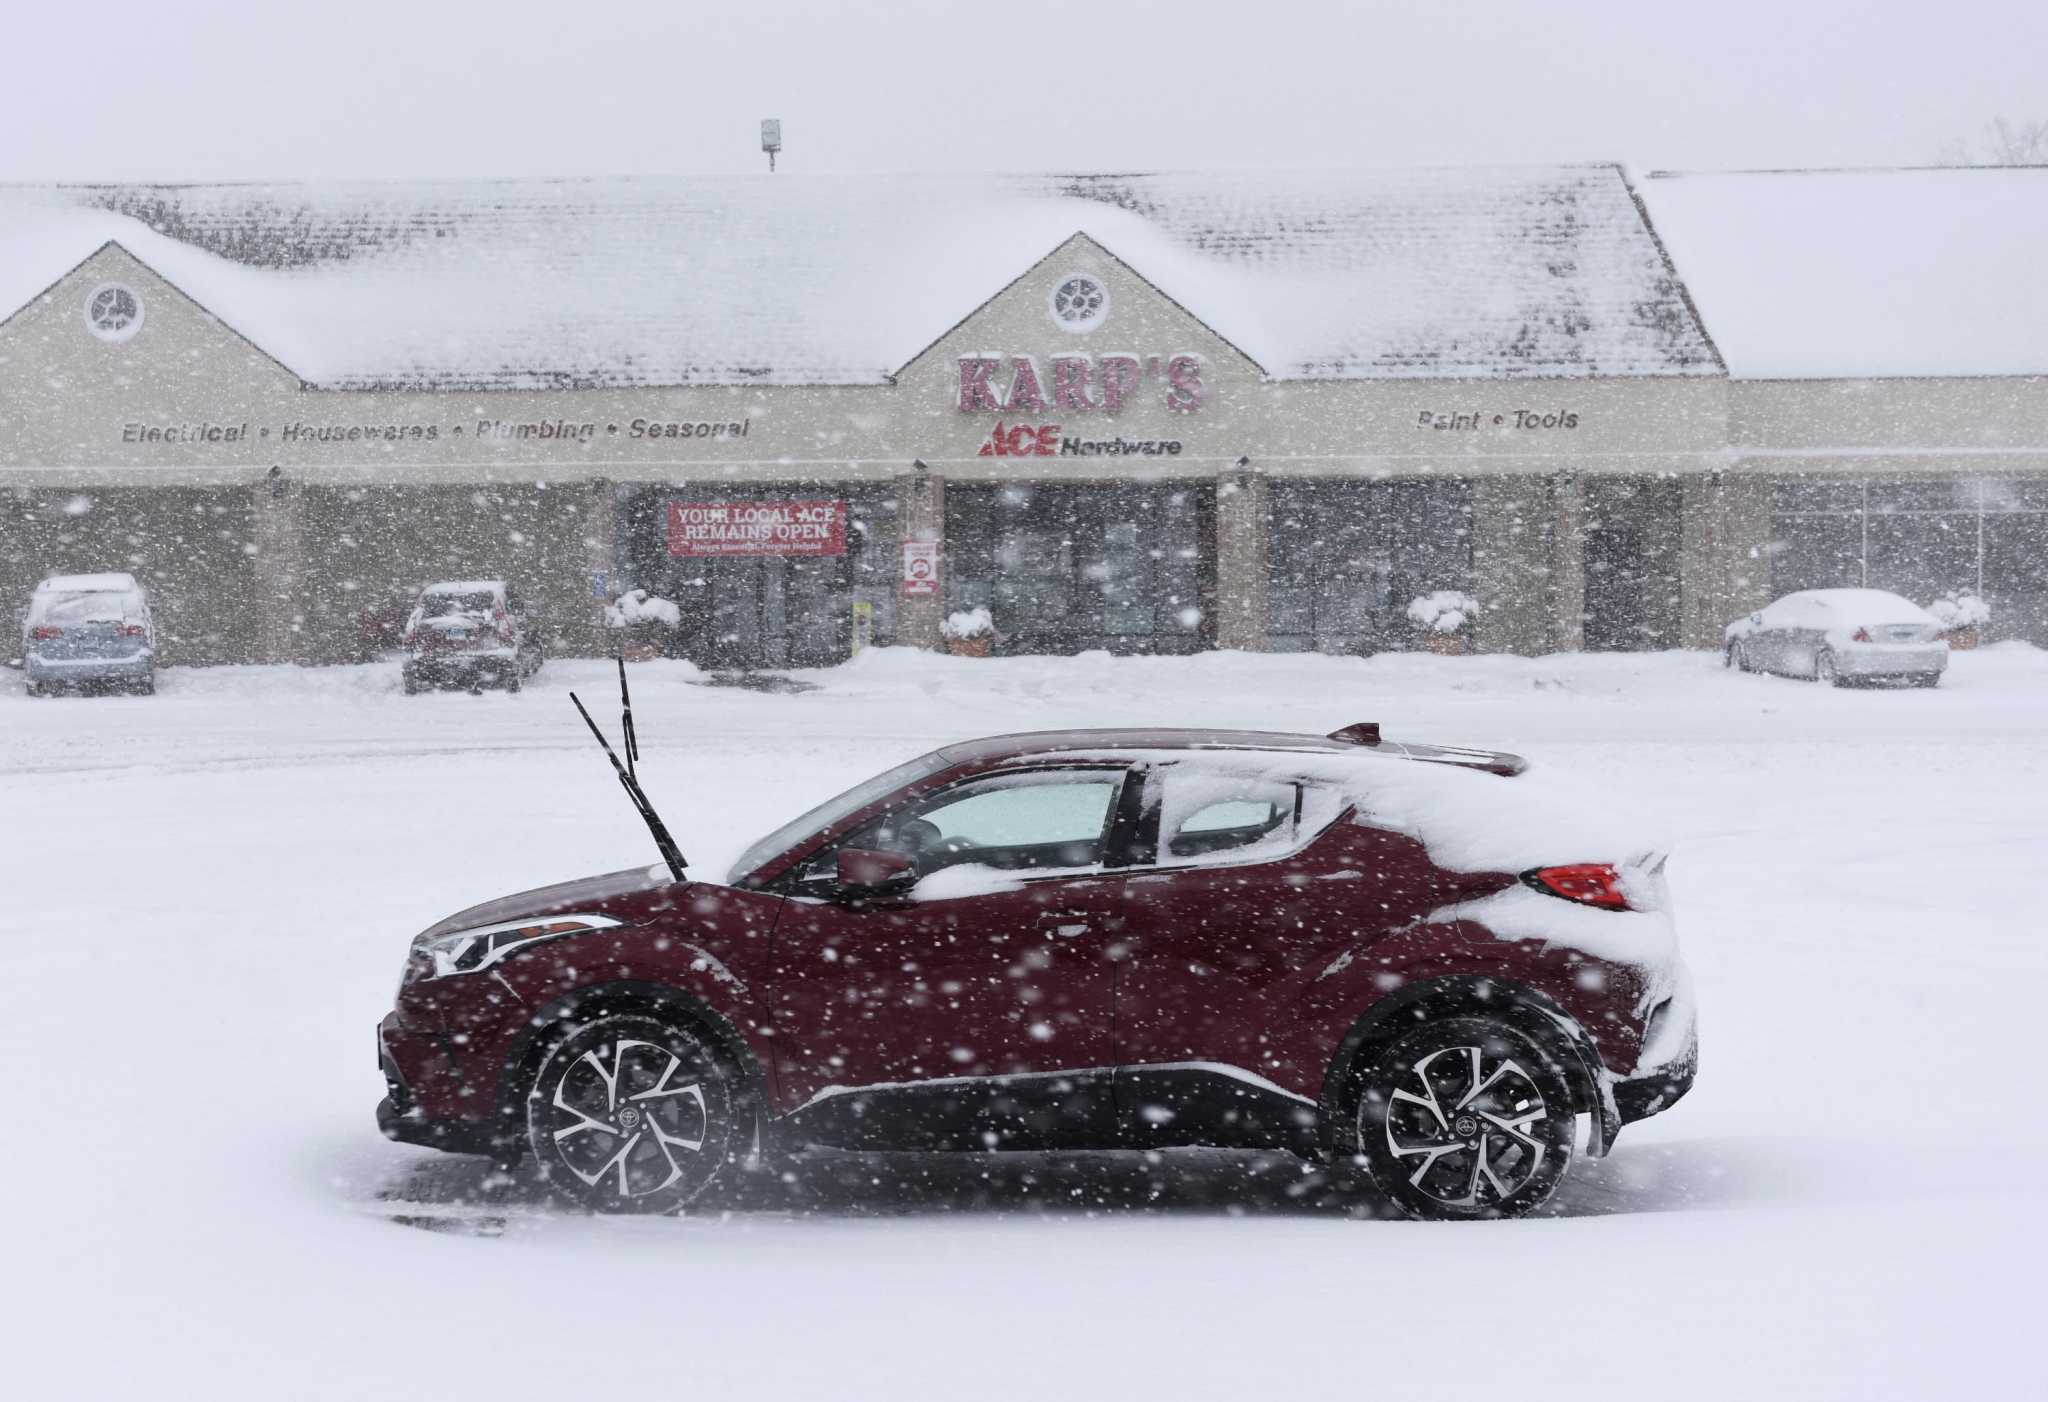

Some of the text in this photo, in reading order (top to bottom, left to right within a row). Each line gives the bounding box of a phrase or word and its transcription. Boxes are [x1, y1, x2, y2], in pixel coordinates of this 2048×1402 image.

[957, 352, 1205, 412] KARP'S
[122, 418, 749, 443] Electrical Housewares Plumbing Seasonal
[1417, 410, 1579, 430] Paint Tools
[977, 420, 1182, 456] ACE Hardware
[678, 507, 835, 524] YOUR LOCAL ACE
[685, 524, 830, 540] REMAINS OPEN
